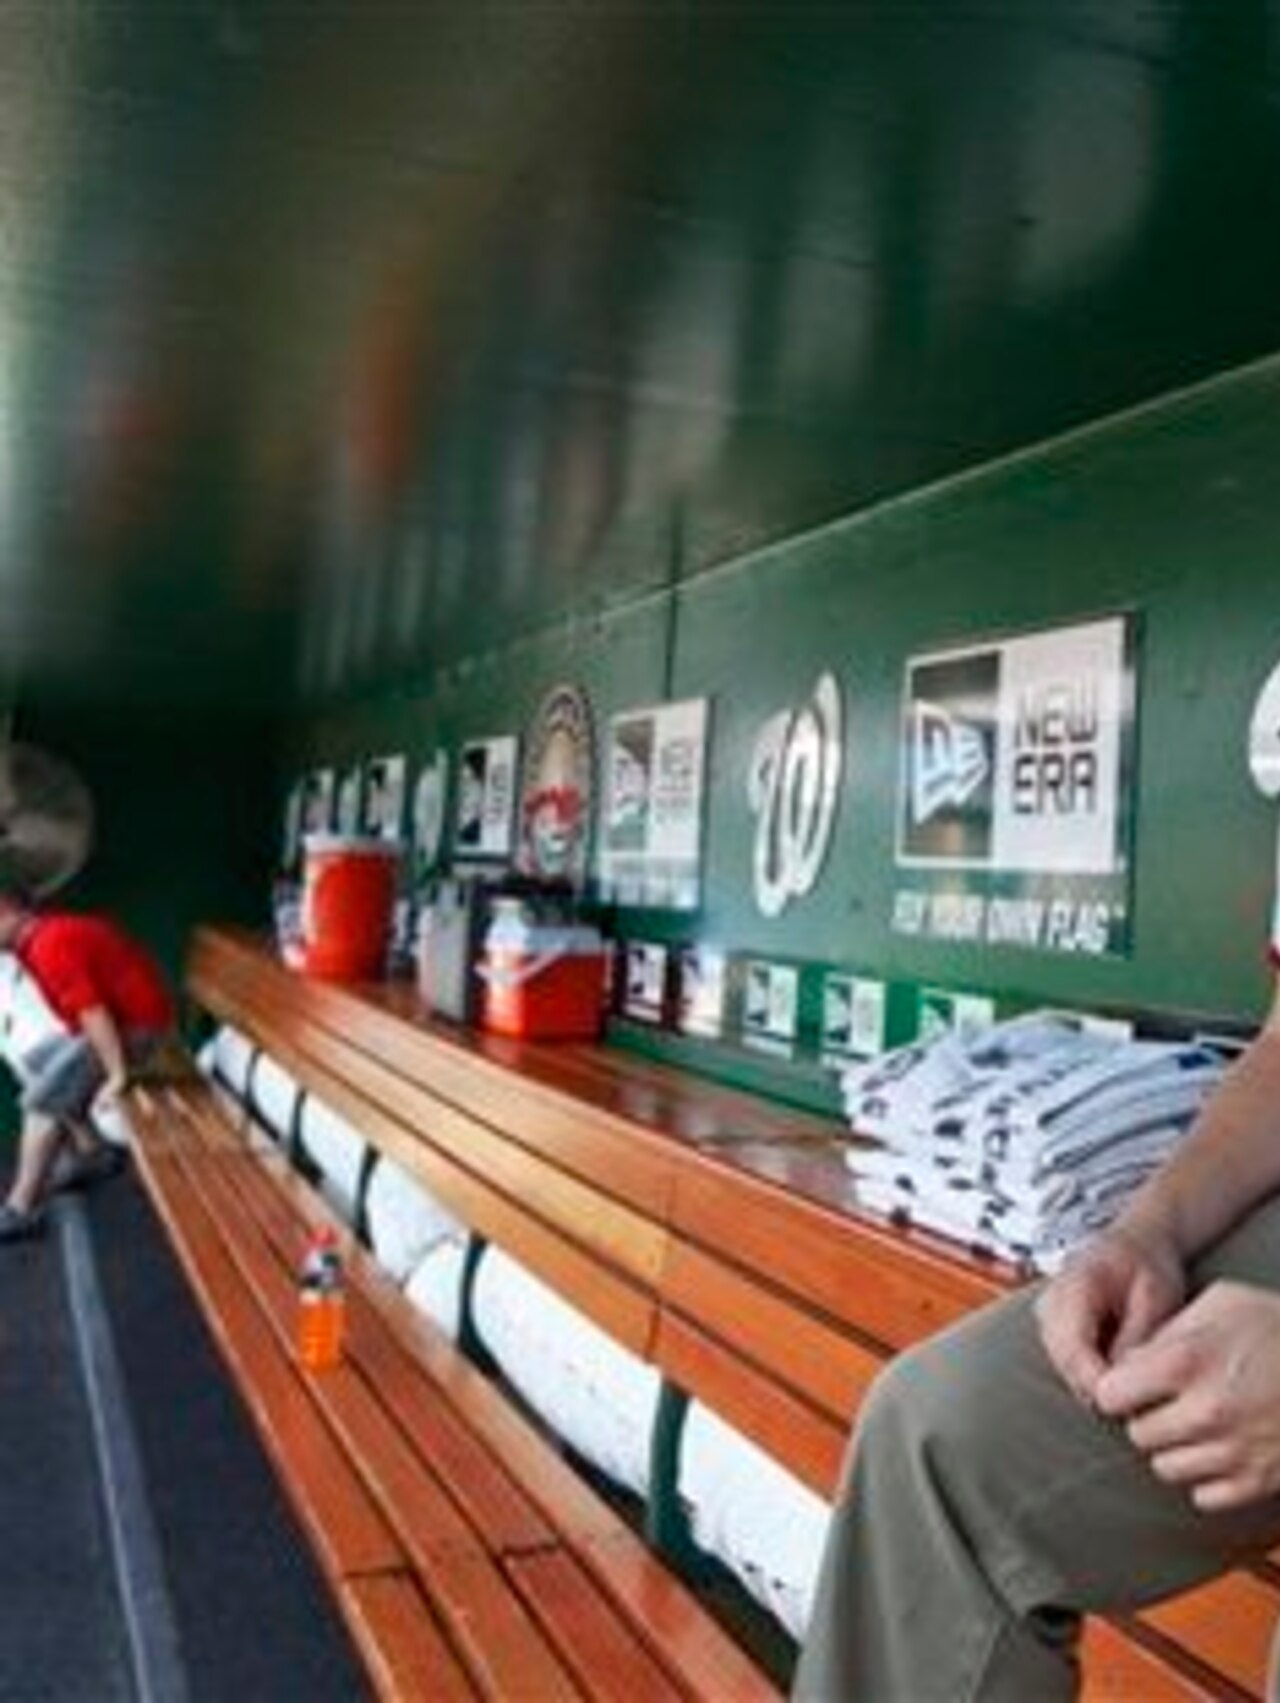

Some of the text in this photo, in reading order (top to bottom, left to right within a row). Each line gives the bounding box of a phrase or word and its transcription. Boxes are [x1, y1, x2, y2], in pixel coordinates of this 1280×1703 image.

[1013, 674, 1098, 748] NEW
[1013, 751, 1098, 815] ERA
[1046, 898, 1110, 953] FLAG
